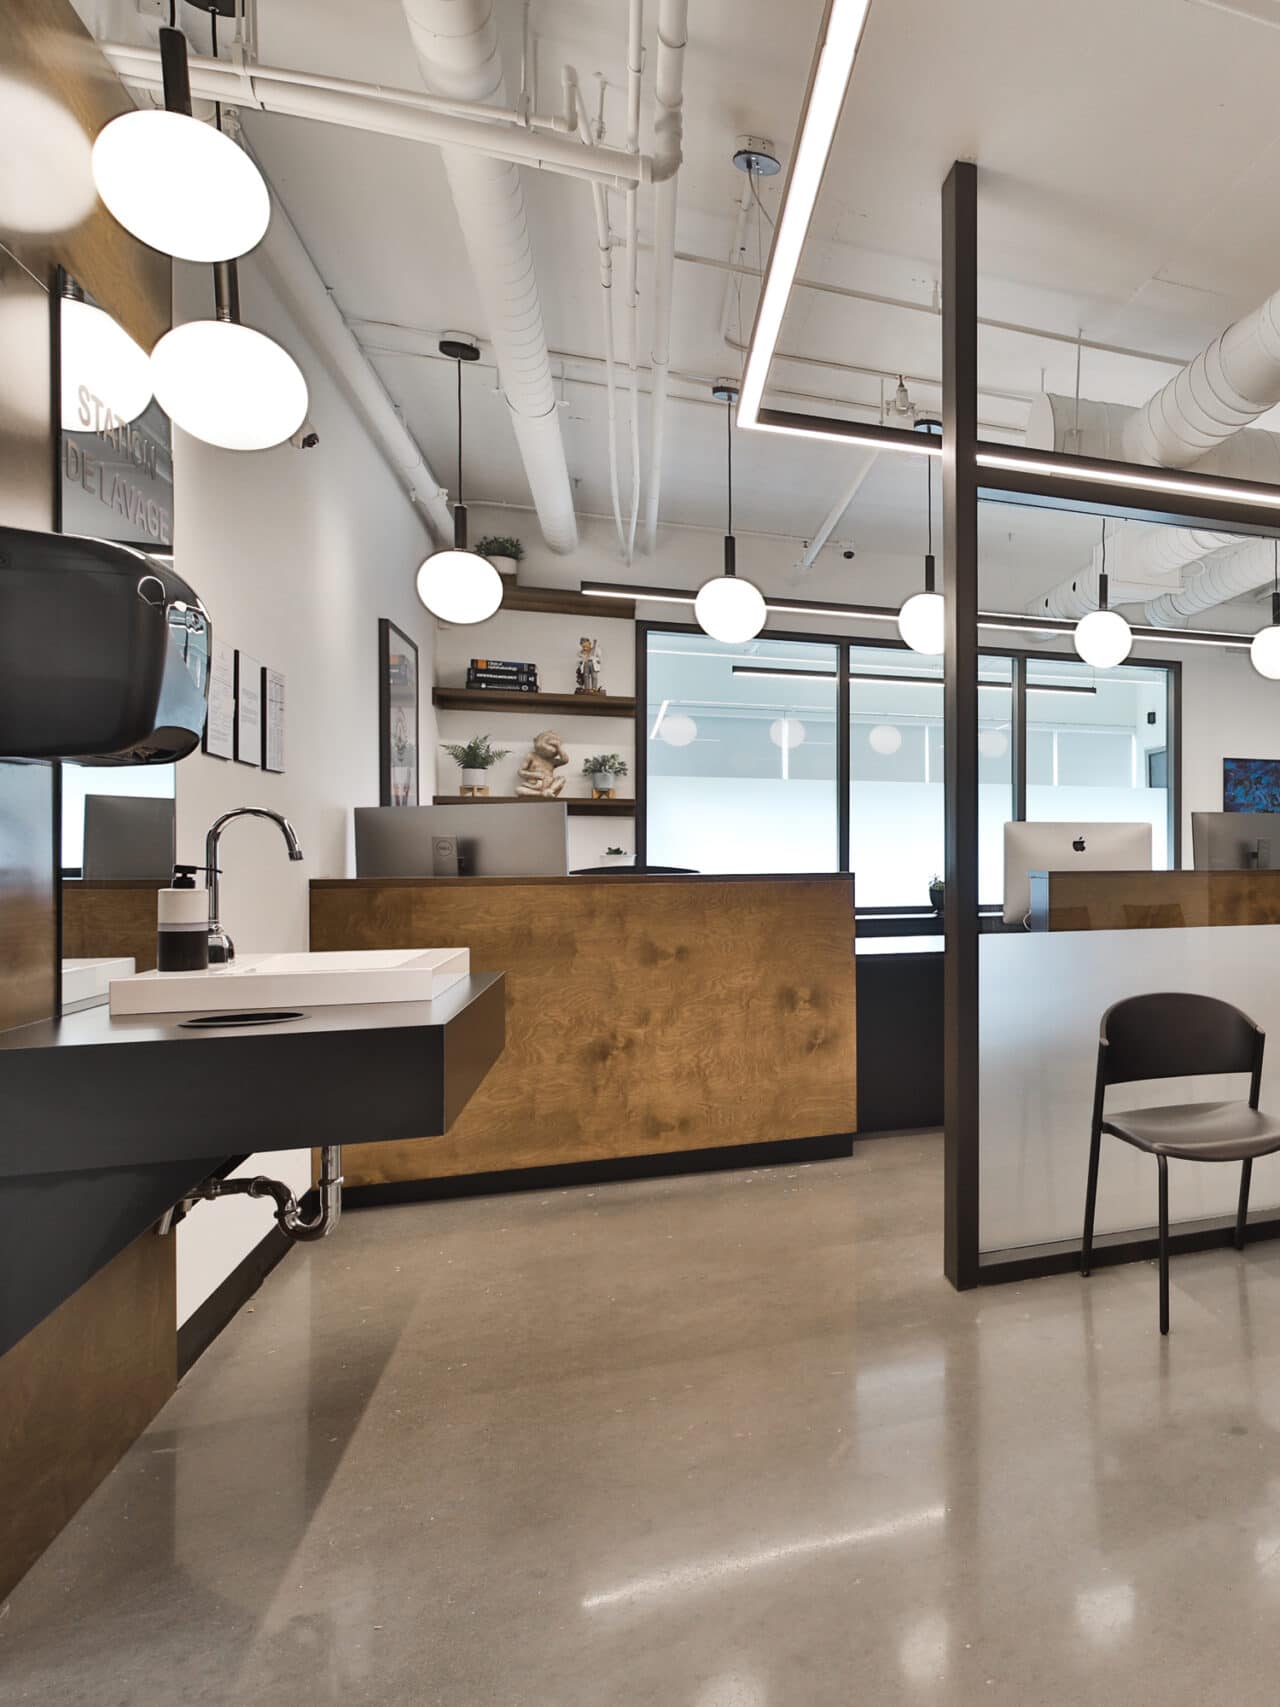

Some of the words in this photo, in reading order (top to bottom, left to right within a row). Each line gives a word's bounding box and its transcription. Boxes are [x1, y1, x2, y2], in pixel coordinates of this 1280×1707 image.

[78, 384, 157, 480] STATION
[66, 438, 96, 494] DE
[100, 462, 170, 545] LAVAGE
